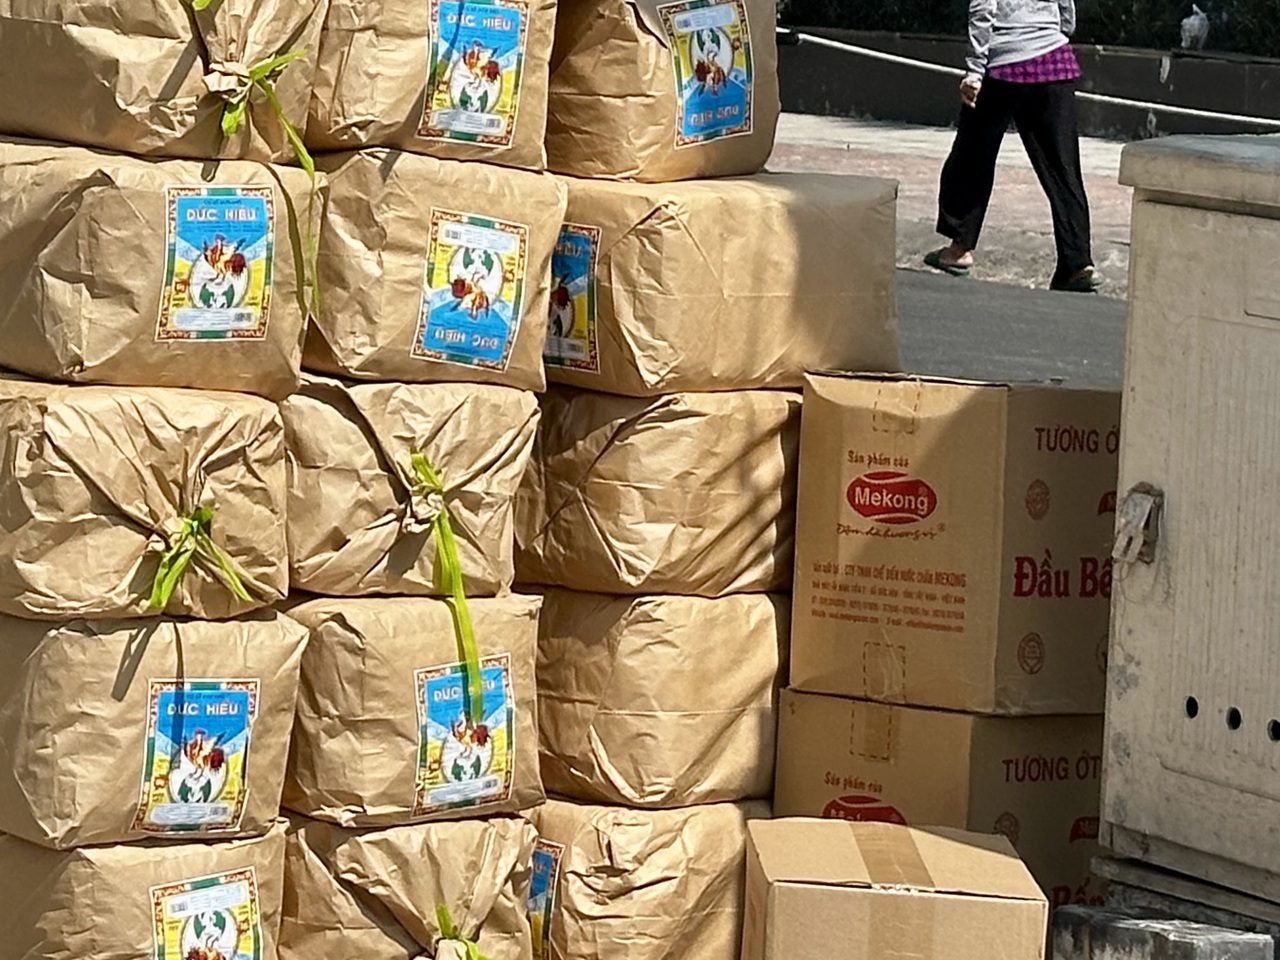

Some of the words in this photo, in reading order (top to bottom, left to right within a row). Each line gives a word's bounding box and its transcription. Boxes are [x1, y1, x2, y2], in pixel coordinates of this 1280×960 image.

[1034, 424, 1099, 454] TƯƠNG
[855, 486, 929, 515] Mekong
[1013, 548, 1070, 598] Đầu
[1002, 754, 1069, 783] TƯƠNG
